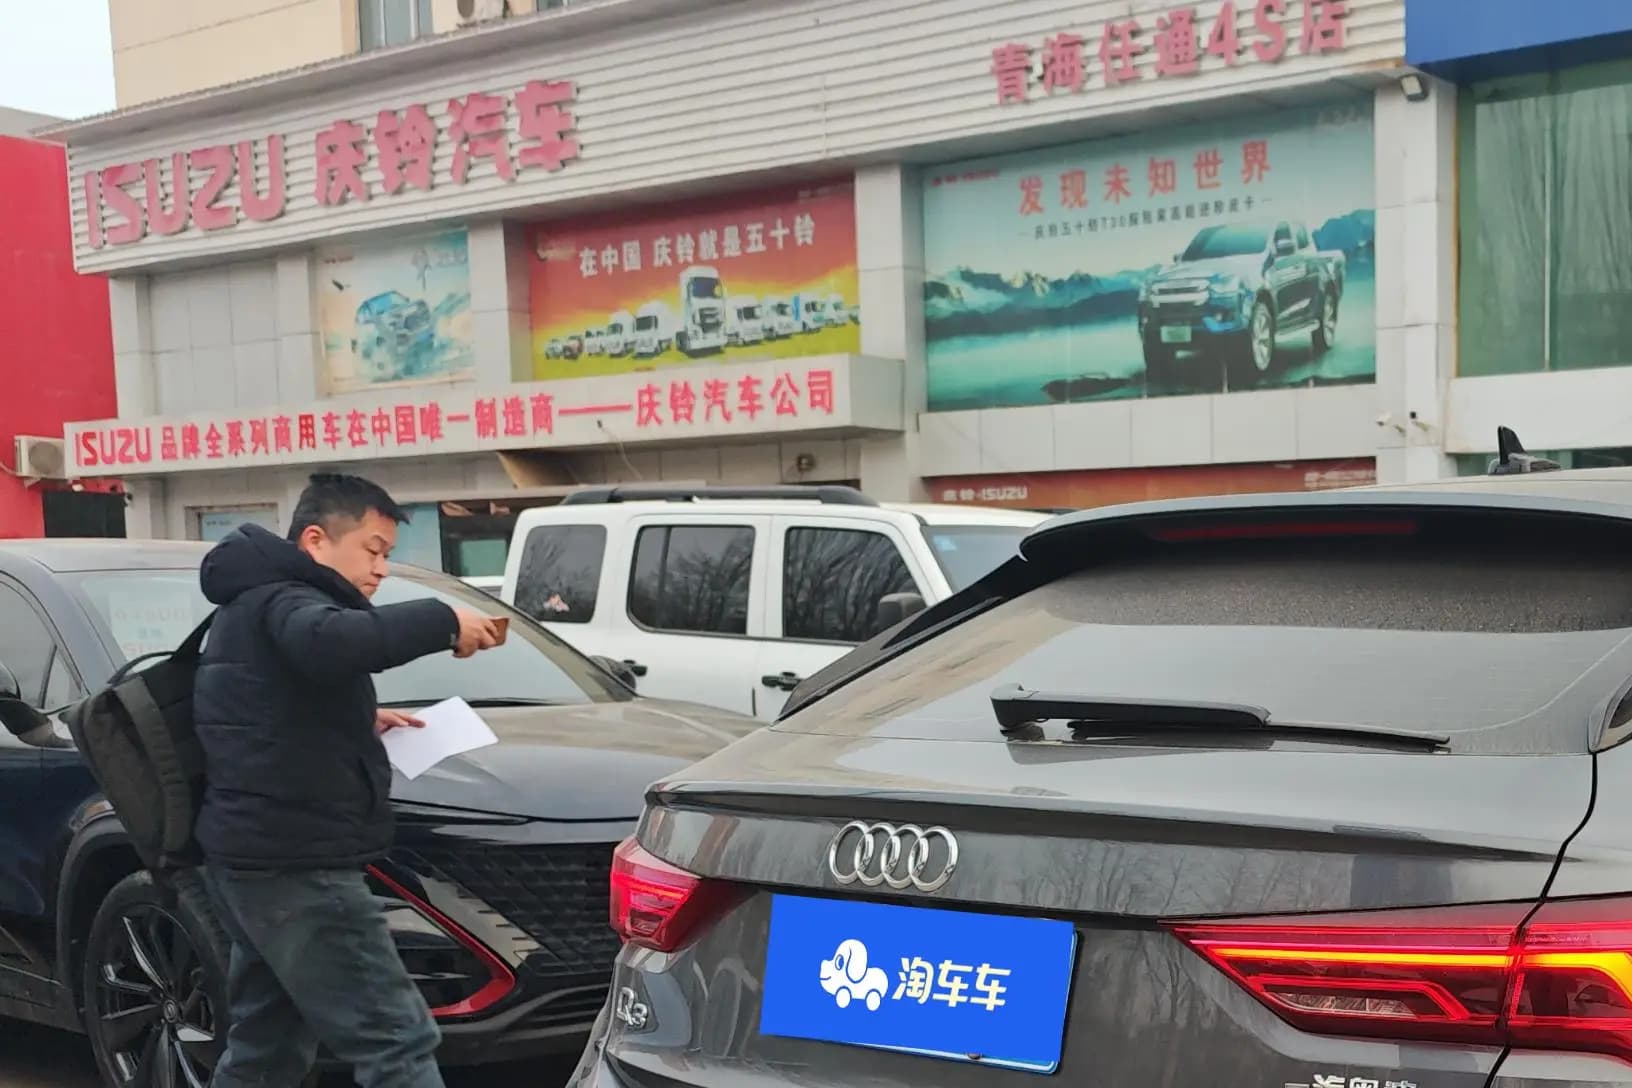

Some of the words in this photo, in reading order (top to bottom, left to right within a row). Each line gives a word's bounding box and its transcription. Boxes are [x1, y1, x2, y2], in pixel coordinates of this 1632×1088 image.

[991, 0, 1349, 104] 青海任通4S店
[85, 134, 286, 248] ISUZU
[314, 79, 580, 206] 庆铃汽车
[1018, 140, 1271, 216] 发现未知世界
[579, 240, 641, 278] 在中国
[653, 213, 815, 267] 庆铃就是五十铃
[75, 428, 152, 467] ISUZU
[616, 986, 648, 1028] Q3
